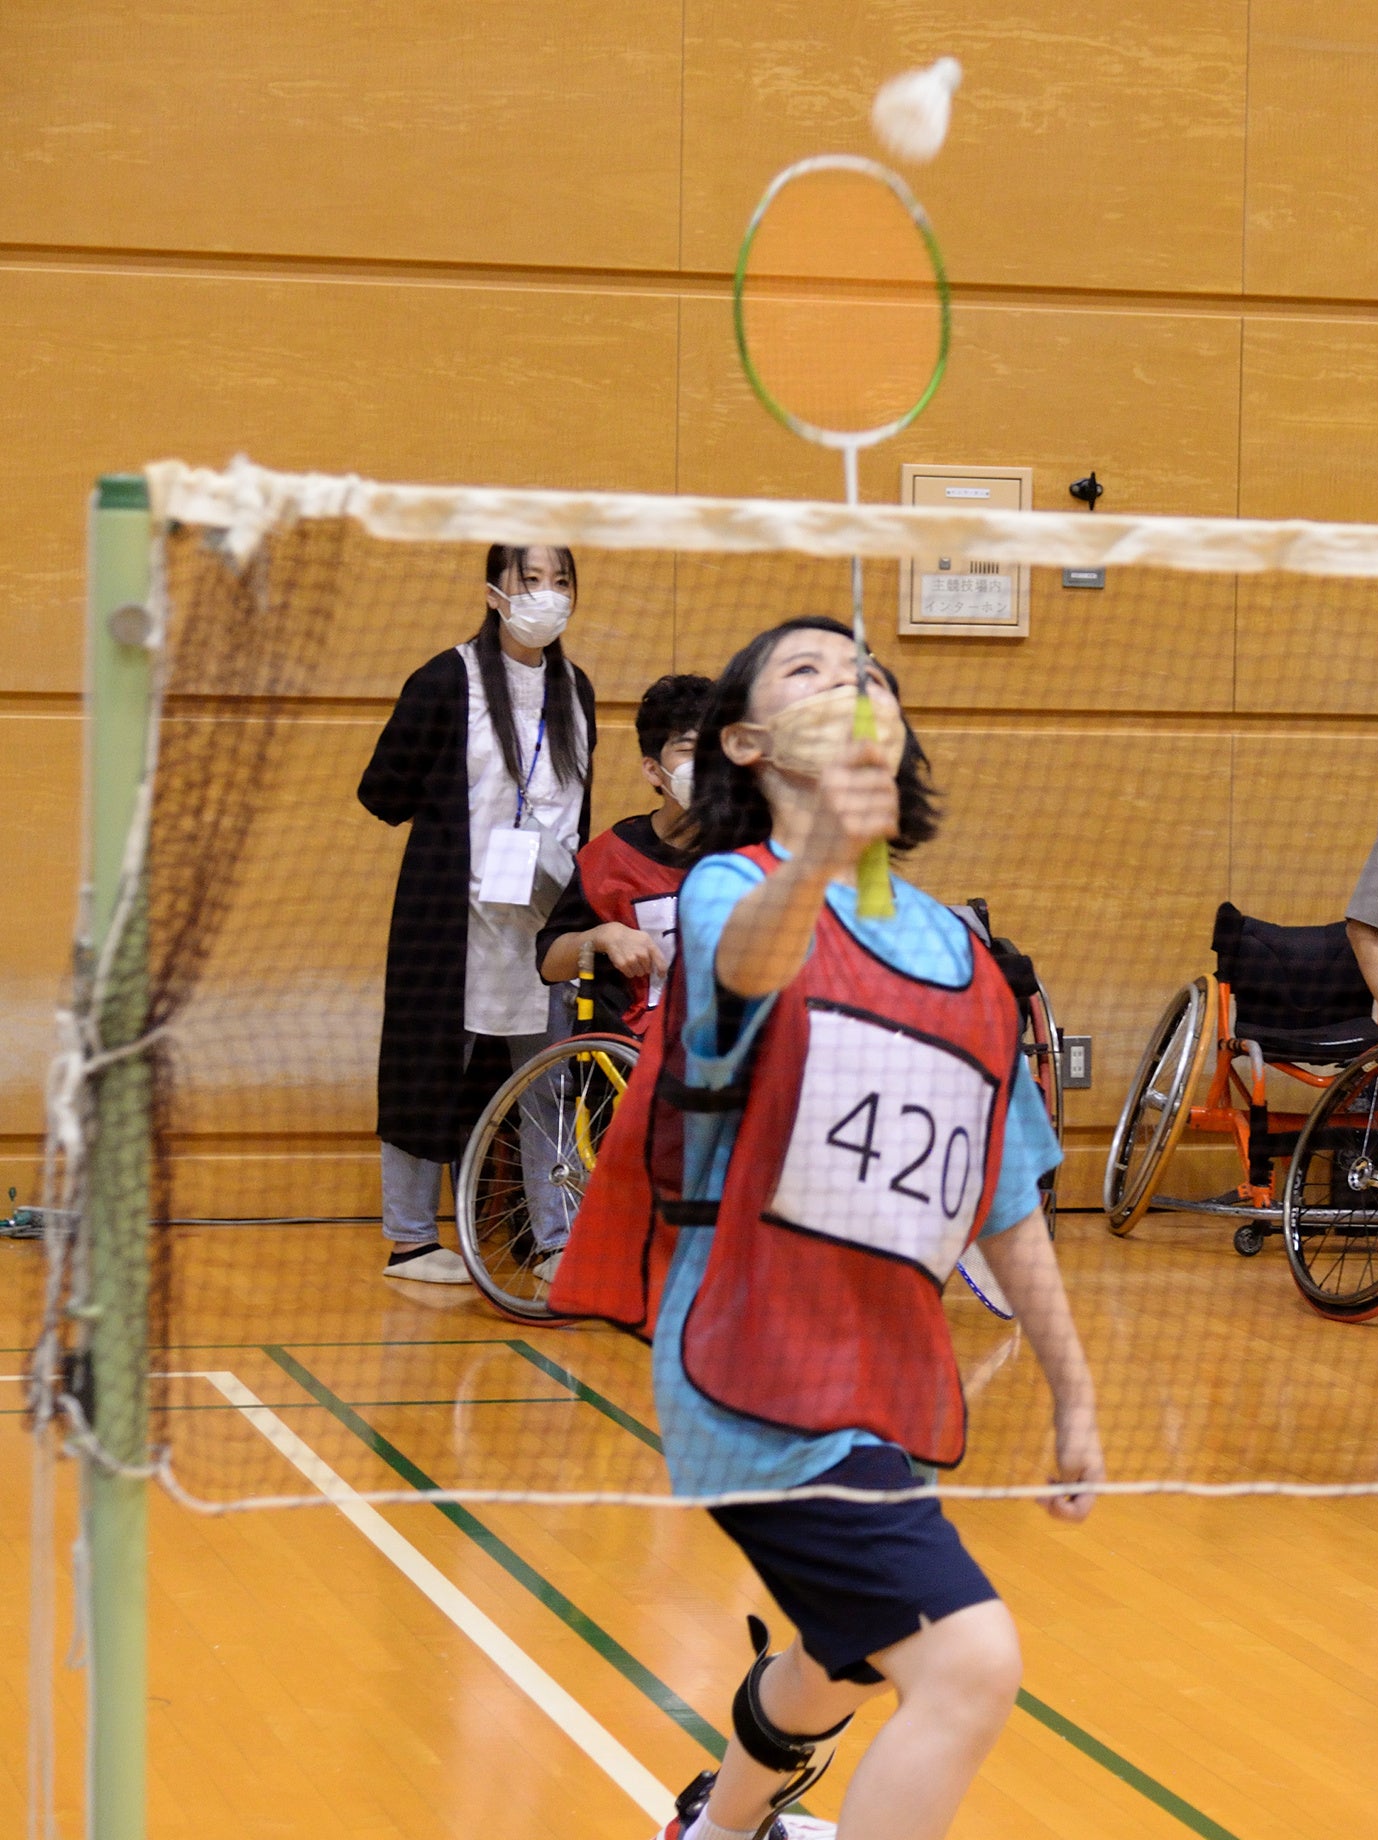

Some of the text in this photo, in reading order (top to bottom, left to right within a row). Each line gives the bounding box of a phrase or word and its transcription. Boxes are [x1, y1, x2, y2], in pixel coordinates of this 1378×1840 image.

[931, 579, 1001, 592] 主競技場内
[926, 601, 1007, 613] インターホン
[826, 1091, 970, 1220] 420
